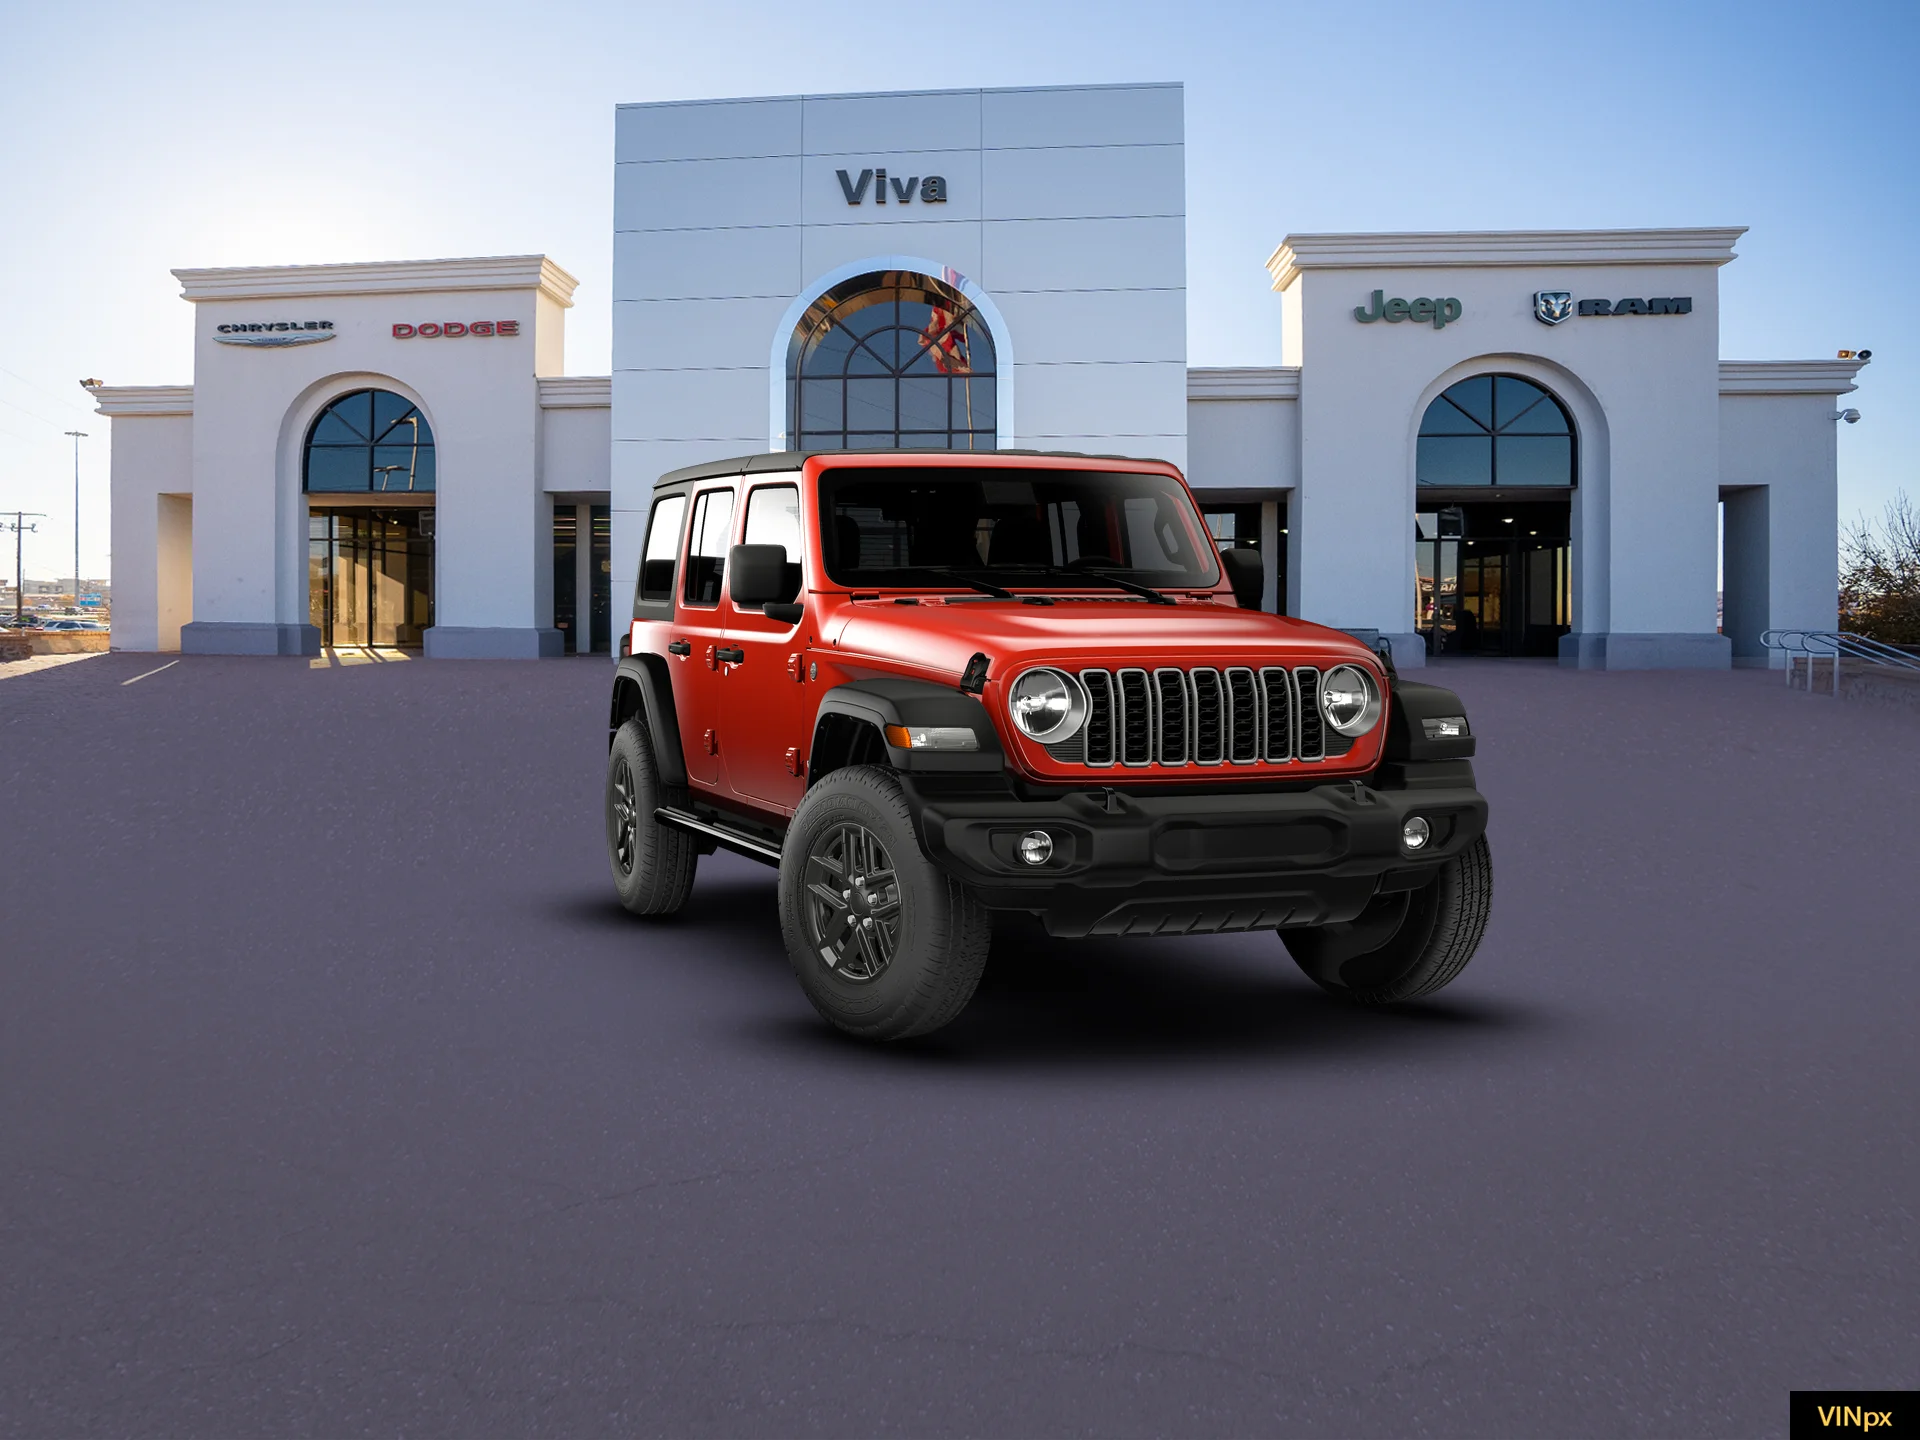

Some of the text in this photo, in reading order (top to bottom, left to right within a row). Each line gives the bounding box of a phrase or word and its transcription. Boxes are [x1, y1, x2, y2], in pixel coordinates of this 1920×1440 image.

[835, 168, 947, 205] Viva
[1354, 289, 1462, 329] Jeep
[1578, 297, 1692, 316] RAM
[217, 320, 334, 333] CHRYSLER
[392, 320, 520, 339] DODGE
